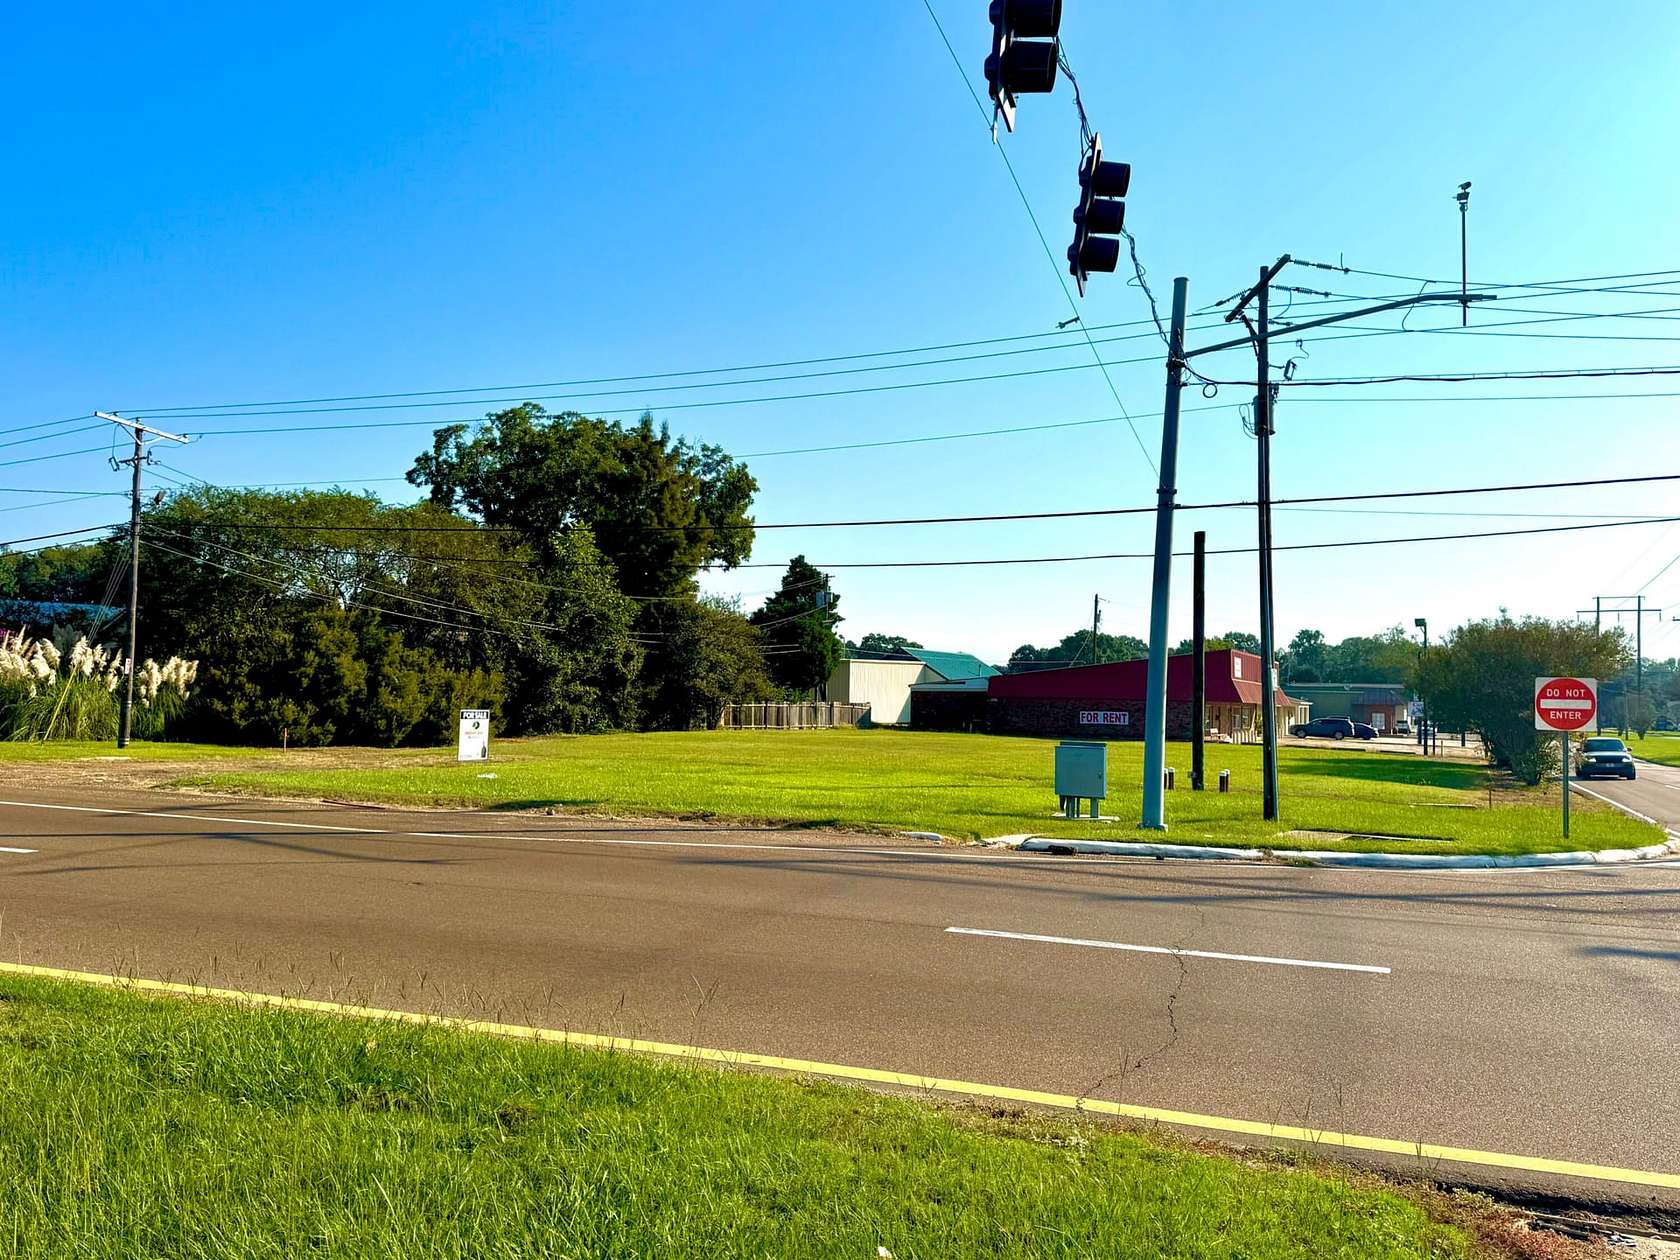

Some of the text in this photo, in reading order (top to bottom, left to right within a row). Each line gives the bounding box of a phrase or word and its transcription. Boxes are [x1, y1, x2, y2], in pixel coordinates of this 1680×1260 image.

[1546, 688, 1585, 697] DO NOT
[1081, 712, 1127, 723] FOR RENT
[1550, 711, 1581, 719] ENTER
